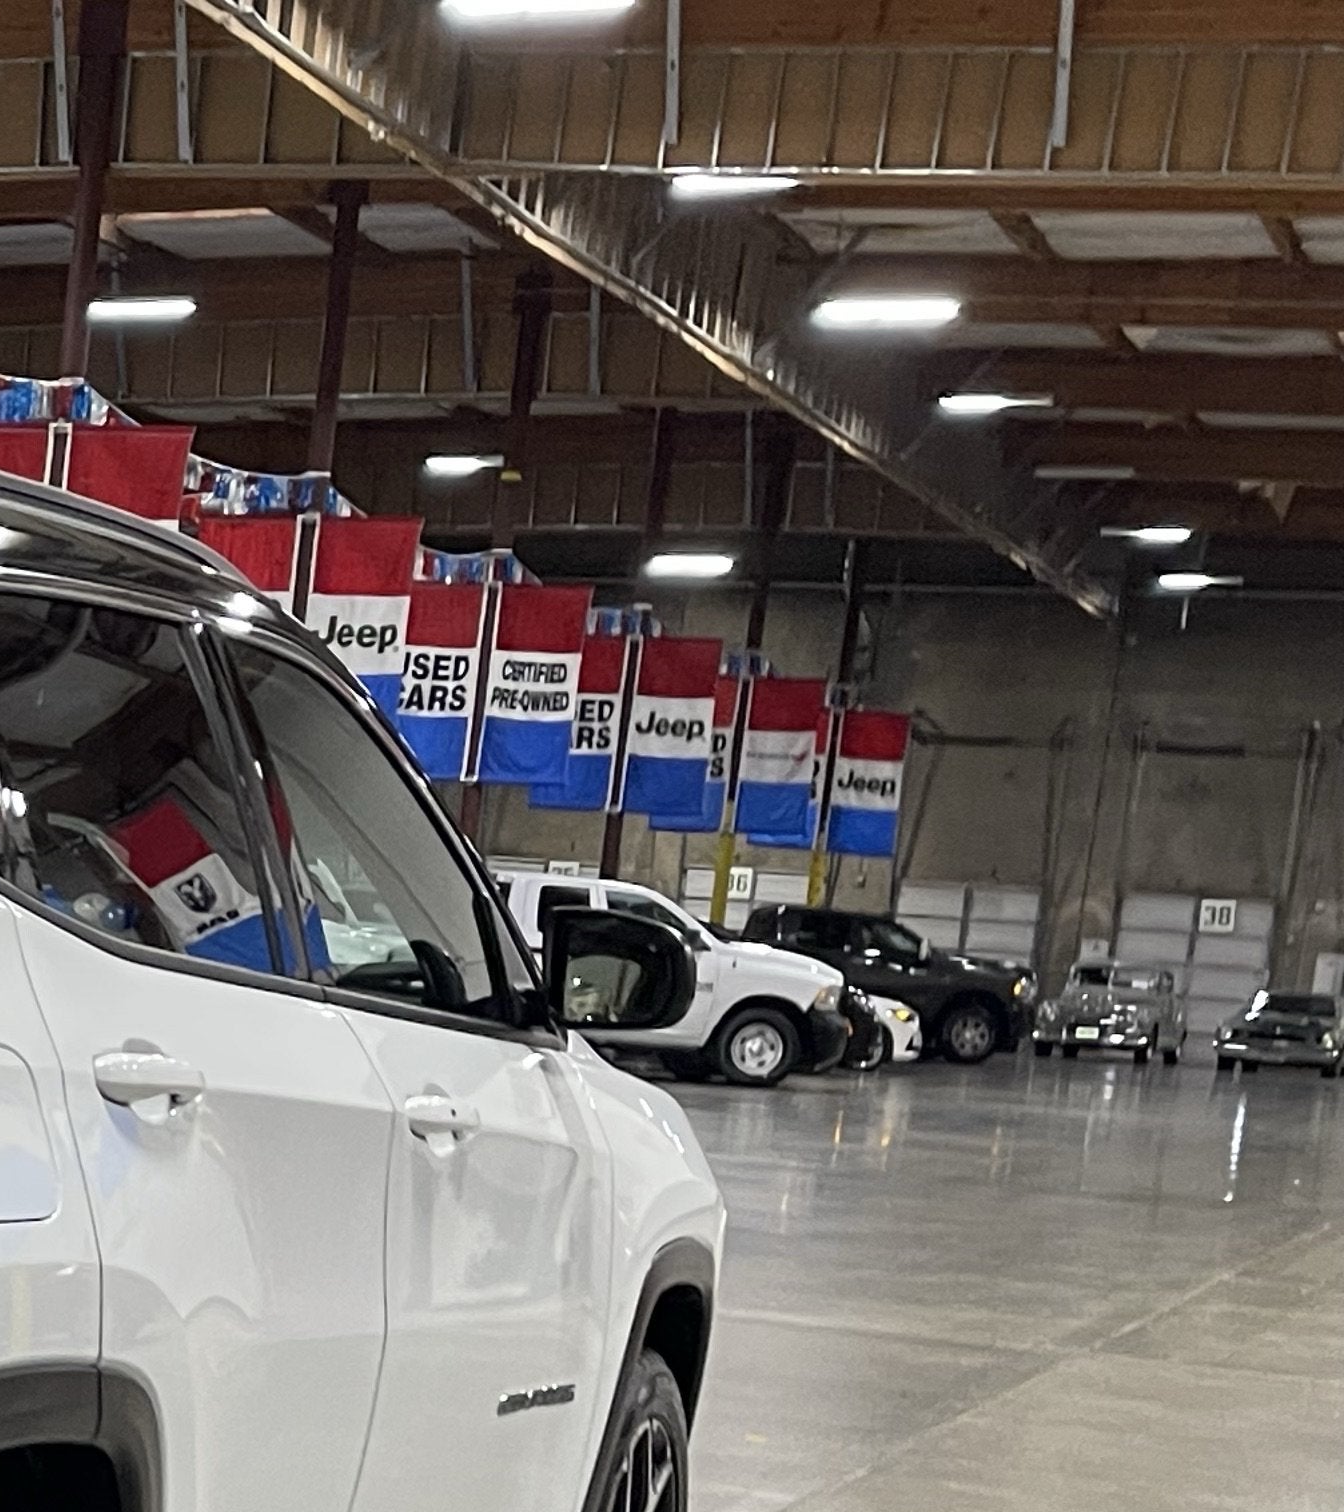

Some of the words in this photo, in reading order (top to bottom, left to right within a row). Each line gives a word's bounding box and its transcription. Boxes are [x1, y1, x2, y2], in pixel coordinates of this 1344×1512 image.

[316, 615, 399, 653] Jeep
[502, 659, 568, 684] CERTIFIED
[399, 683, 467, 712] ARS
[490, 686, 569, 712] PRE-OWNED
[635, 710, 705, 743] Jeep
[837, 768, 896, 798] Jeep
